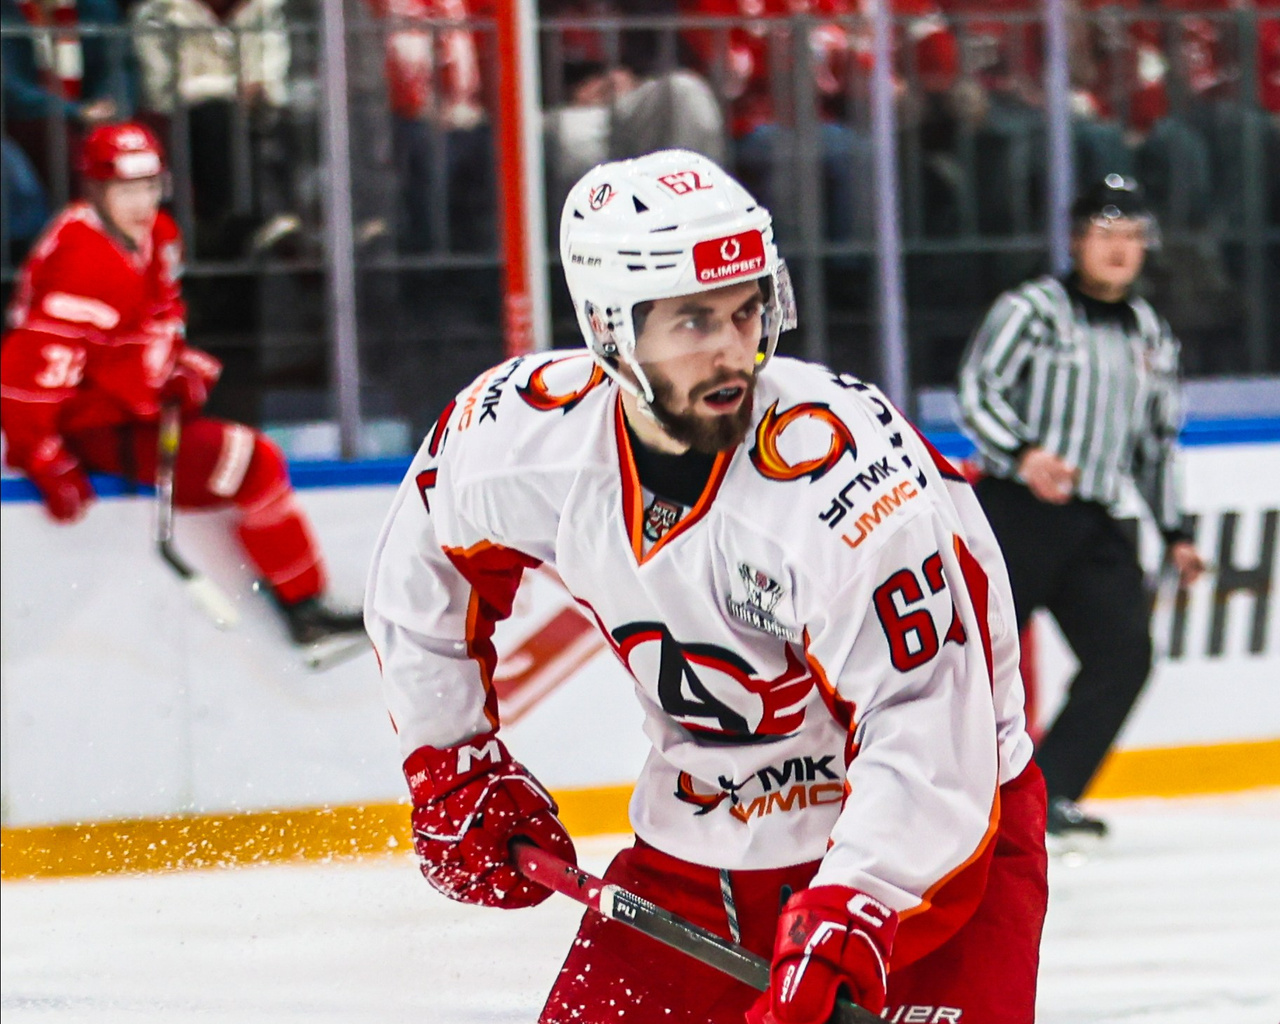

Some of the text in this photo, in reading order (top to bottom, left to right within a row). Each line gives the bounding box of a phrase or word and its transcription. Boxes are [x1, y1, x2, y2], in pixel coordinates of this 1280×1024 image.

[658, 170, 714, 196] 62
[700, 256, 763, 281] OLIMPBET
[818, 456, 898, 530] УГМК
[841, 480, 918, 549] UMMC
